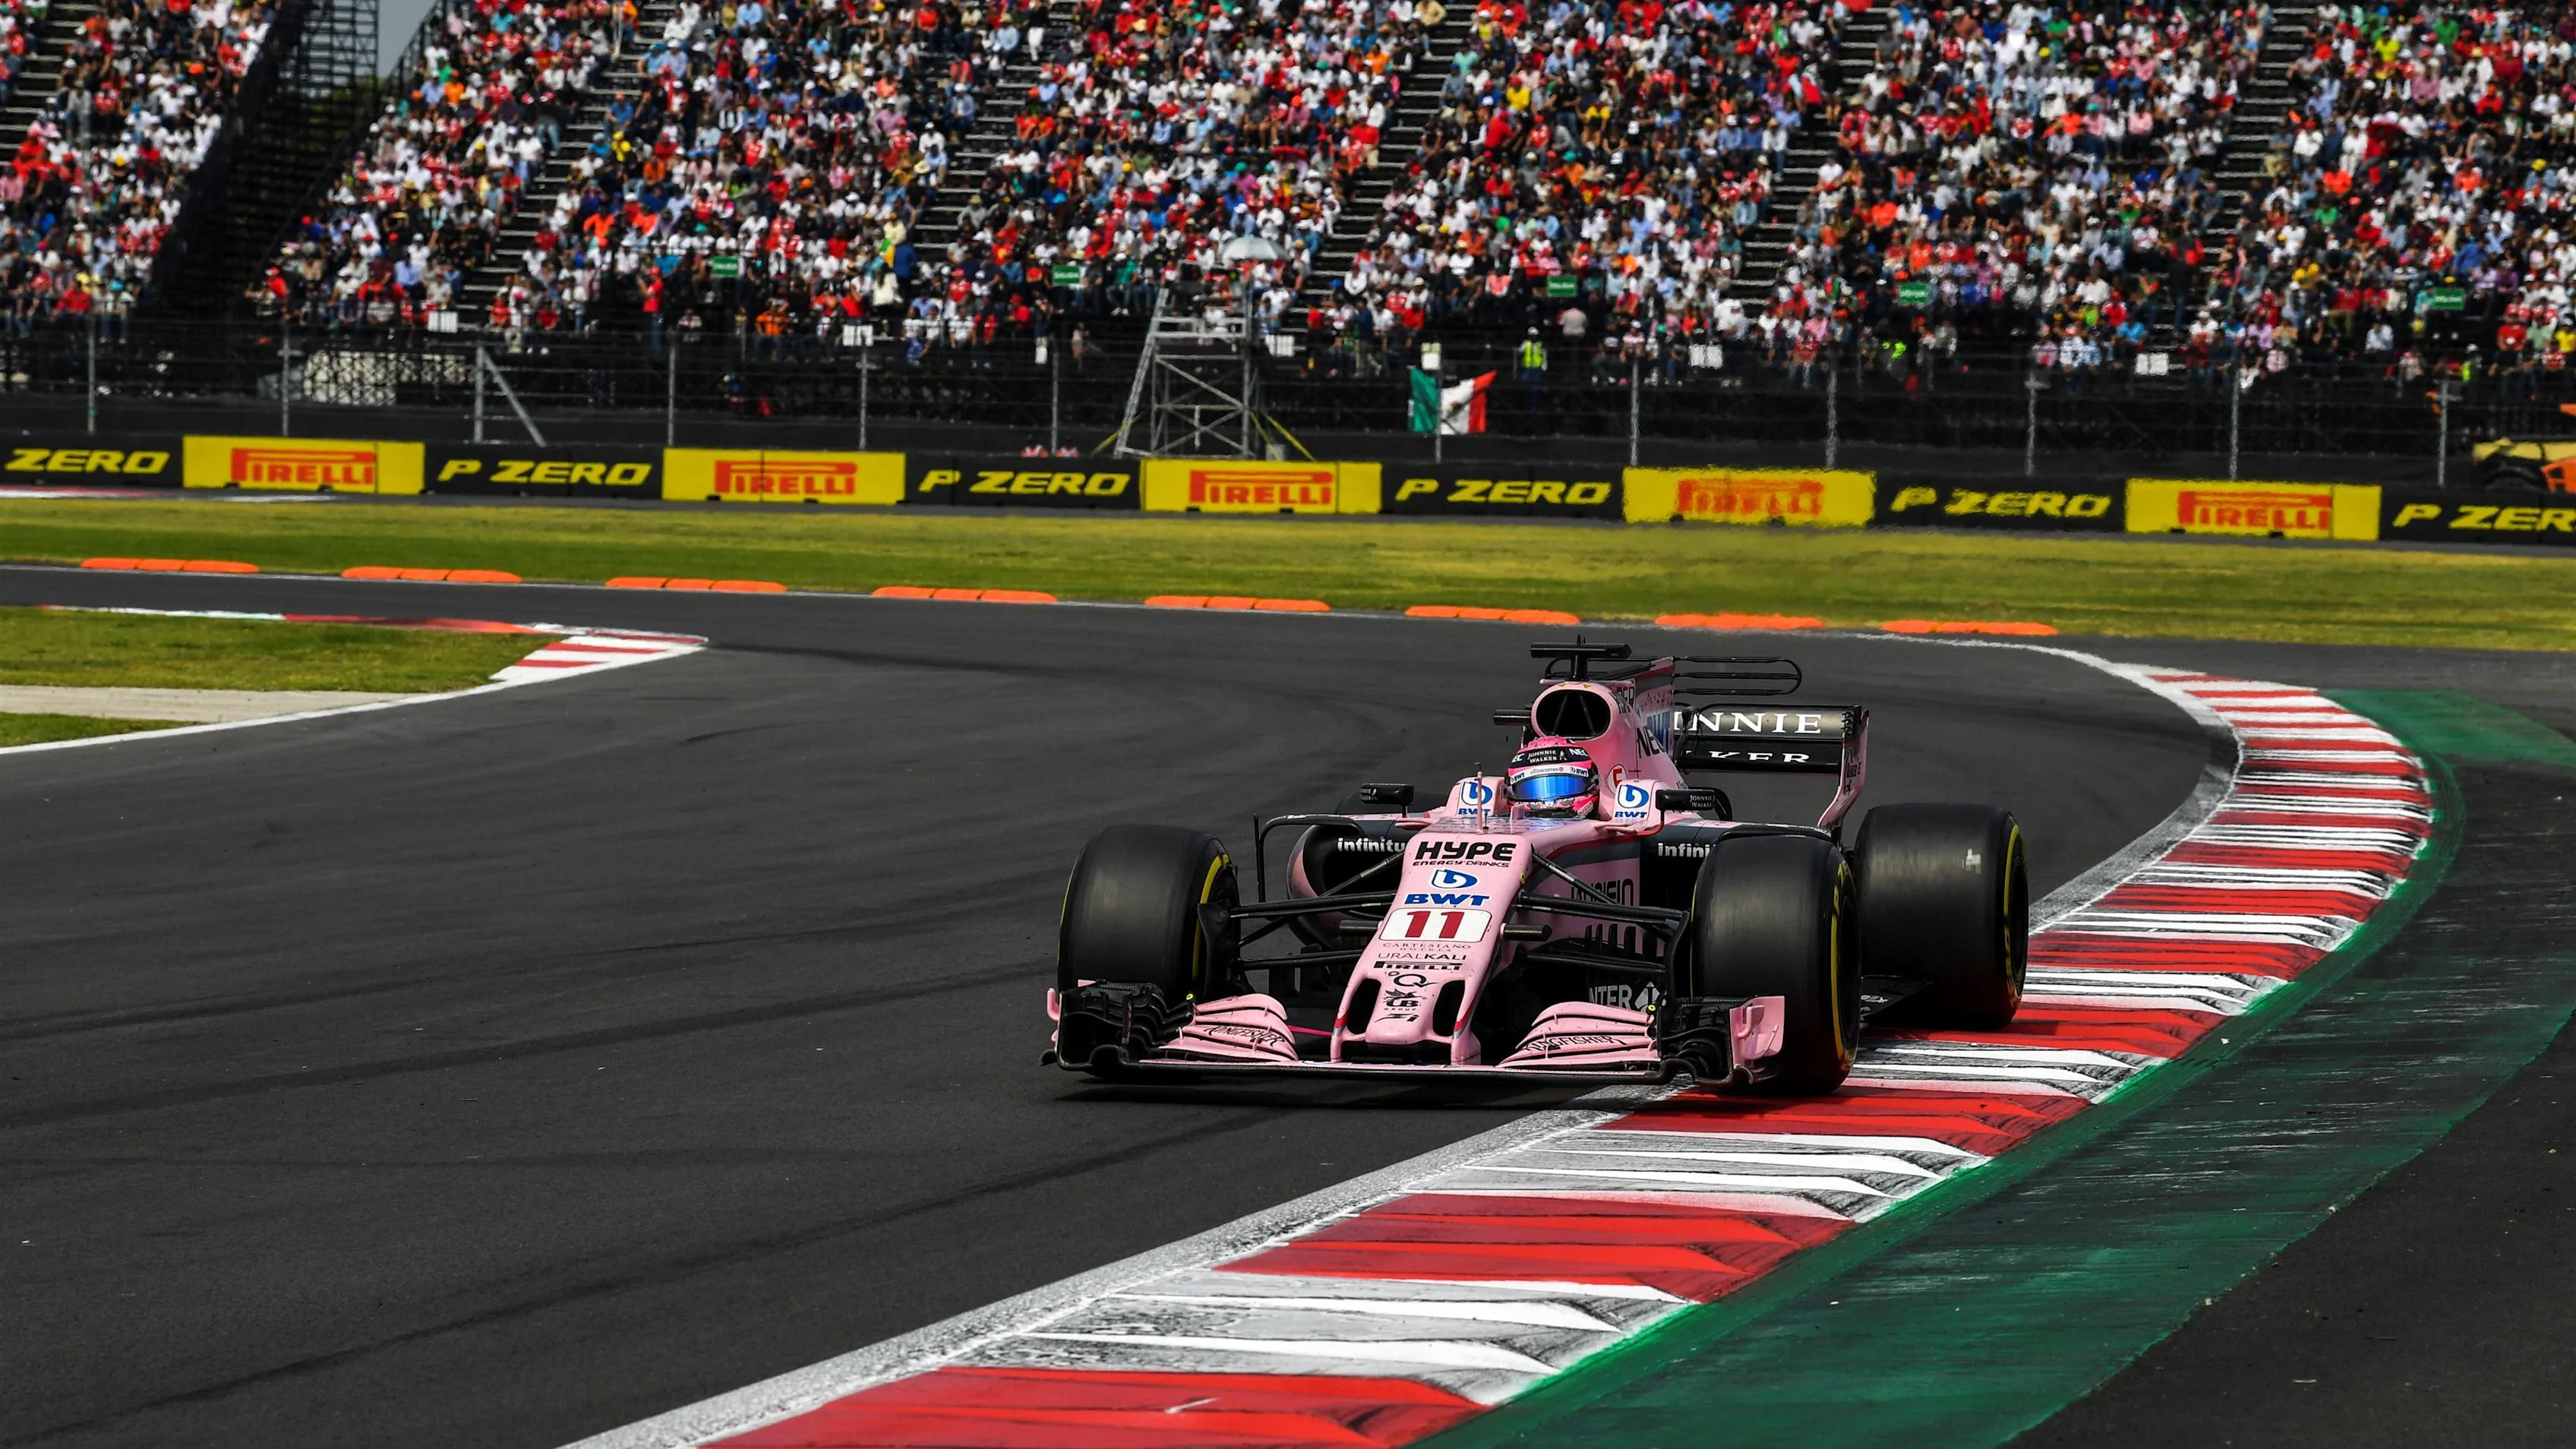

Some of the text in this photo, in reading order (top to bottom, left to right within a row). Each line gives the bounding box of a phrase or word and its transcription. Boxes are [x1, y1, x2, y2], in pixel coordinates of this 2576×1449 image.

[5, 448, 169, 474] ZERO
[231, 447, 377, 485] PIRELLI
[437, 459, 652, 486] P ZERO
[714, 459, 857, 495] PIRELLI
[919, 469, 1130, 496] P ZERO
[1189, 469, 1334, 505] PIRELLI
[1395, 478, 1612, 504] P ZERO
[1890, 487, 2111, 518] P ZERO
[2177, 490, 2333, 531] PIRELLI
[2393, 504, 2442, 528] P
[1527, 750, 1557, 759] JOHNNIE
[1569, 748, 1589, 757] NEC
[1415, 841, 1517, 860] HYPE
[1404, 894, 1490, 906] BWT
[1405, 911, 1465, 939] 11
[1373, 961, 1463, 971] PIRELLI
[1203, 1025, 1286, 1046] KINGFISHER
